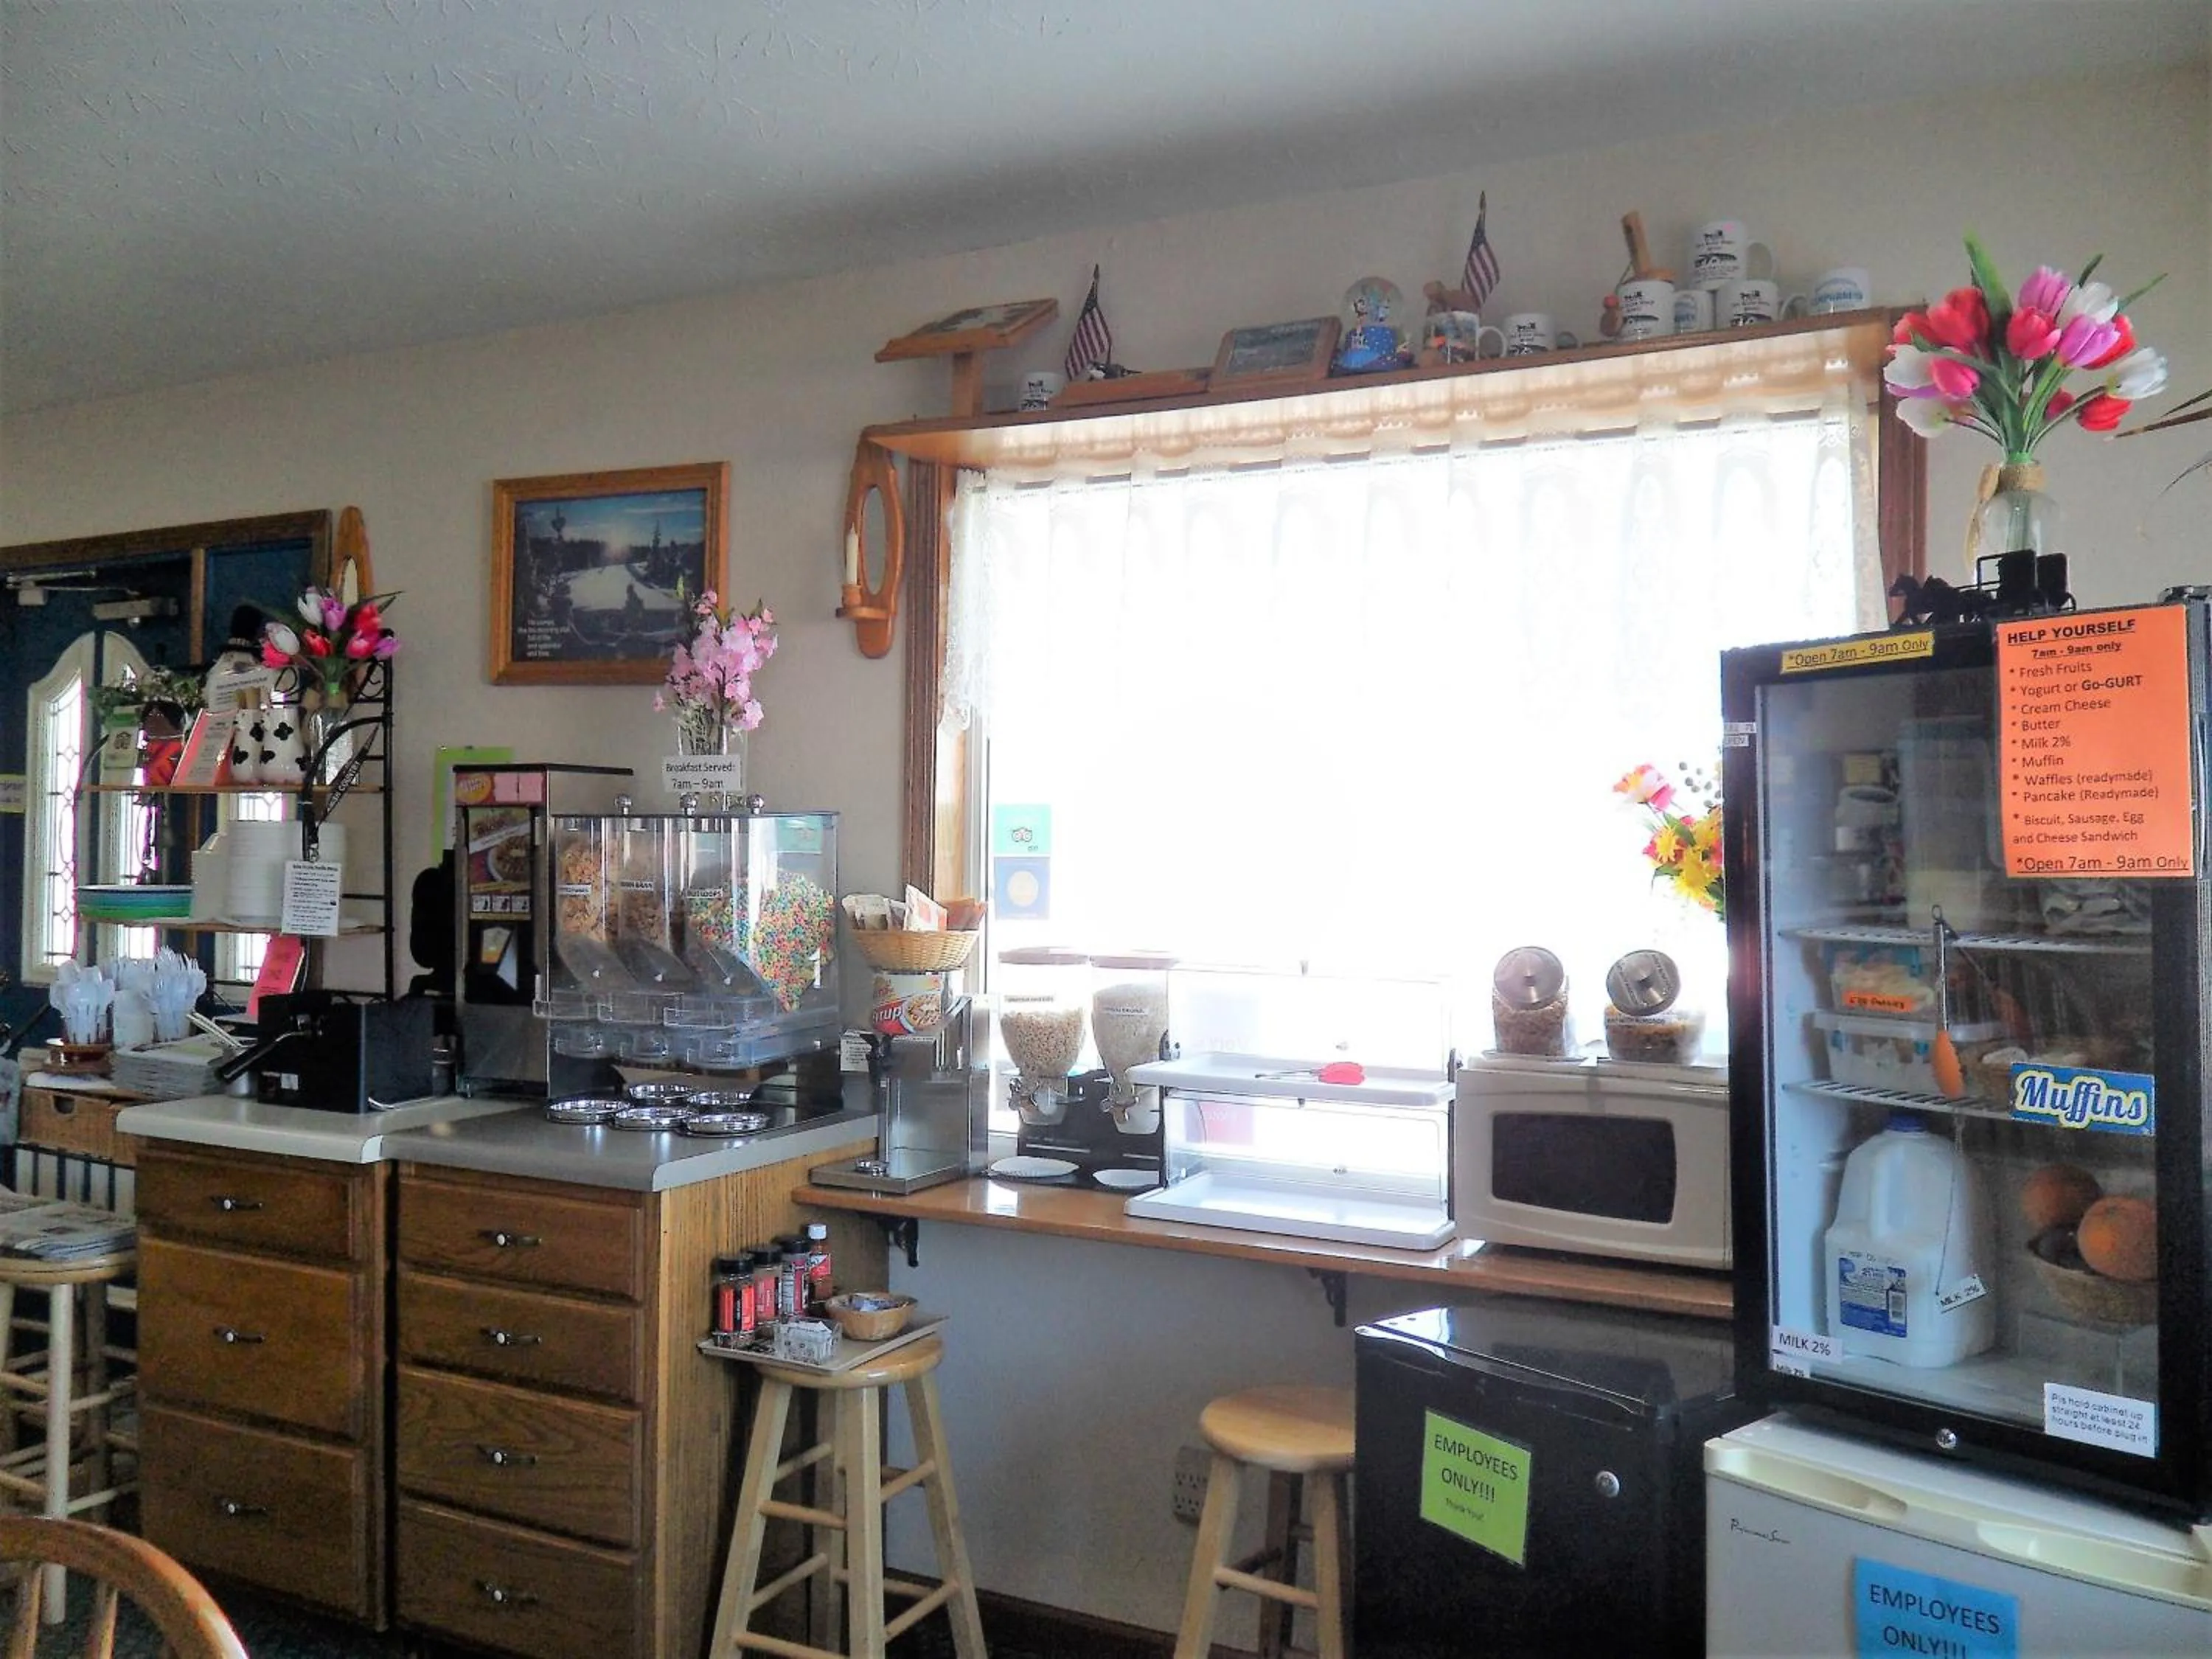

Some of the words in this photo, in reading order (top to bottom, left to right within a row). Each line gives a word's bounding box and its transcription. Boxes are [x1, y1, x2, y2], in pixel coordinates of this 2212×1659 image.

[2008, 630, 2047, 644] HELP
[2051, 619, 2135, 639] YOURSELF
[1831, 647, 1857, 661] 7am
[1869, 642, 1898, 655] 9am
[1902, 639, 1929, 651] Only
[2031, 648, 2057, 658] 7am
[2067, 644, 2093, 655] 9am
[2096, 641, 2121, 653] only
[2020, 667, 2053, 678] Fresh
[2056, 662, 2092, 674] Fruits
[2020, 684, 2060, 698] Yogurt
[2064, 683, 2076, 692] or
[2081, 675, 2143, 691] Go-GURT
[2021, 703, 2060, 714] Cream
[2065, 698, 2111, 712] Cheese
[2022, 719, 2060, 731] Butter
[2022, 737, 2048, 749] Milk
[2052, 737, 2071, 748] 2%
[666, 762, 701, 772] Breakfast
[2022, 755, 2064, 767] Muffin
[672, 778, 692, 789] 7am
[702, 778, 723, 788] 9am
[2024, 773, 2073, 786] Waffles
[2077, 769, 2153, 784] (readymade)
[2023, 790, 2075, 802] Pancake
[2080, 787, 2159, 801] (Readymade)
[2024, 814, 2065, 826] Biscuit,
[2068, 813, 2120, 825] Sausage,
[2123, 810, 2144, 824] Egg
[2013, 834, 2034, 844] and
[2037, 832, 2078, 843] Cheese
[2081, 830, 2138, 842] Sandwich
[2069, 855, 2101, 869] 7am
[2118, 855, 2152, 868] 9am
[2157, 855, 2188, 869] Only
[2021, 1076, 2143, 1122] Muffins
[1779, 1333, 1809, 1351] MILK
[1812, 1341, 1831, 1355] 2%
[2068, 1396, 2090, 1408] hold
[2091, 1402, 2128, 1416] cabinet
[2051, 1405, 2088, 1421] straight
[2102, 1415, 2126, 1428] least
[2051, 1416, 2079, 1428] hours
[2081, 1420, 2112, 1435] before
[1434, 1433, 1518, 1481] EMPLOYEES
[1441, 1467, 1495, 1503] ONLY!!!
[1869, 1583, 2001, 1635] EMPLOYEES
[1882, 1626, 1967, 1659] ONLY!!!
